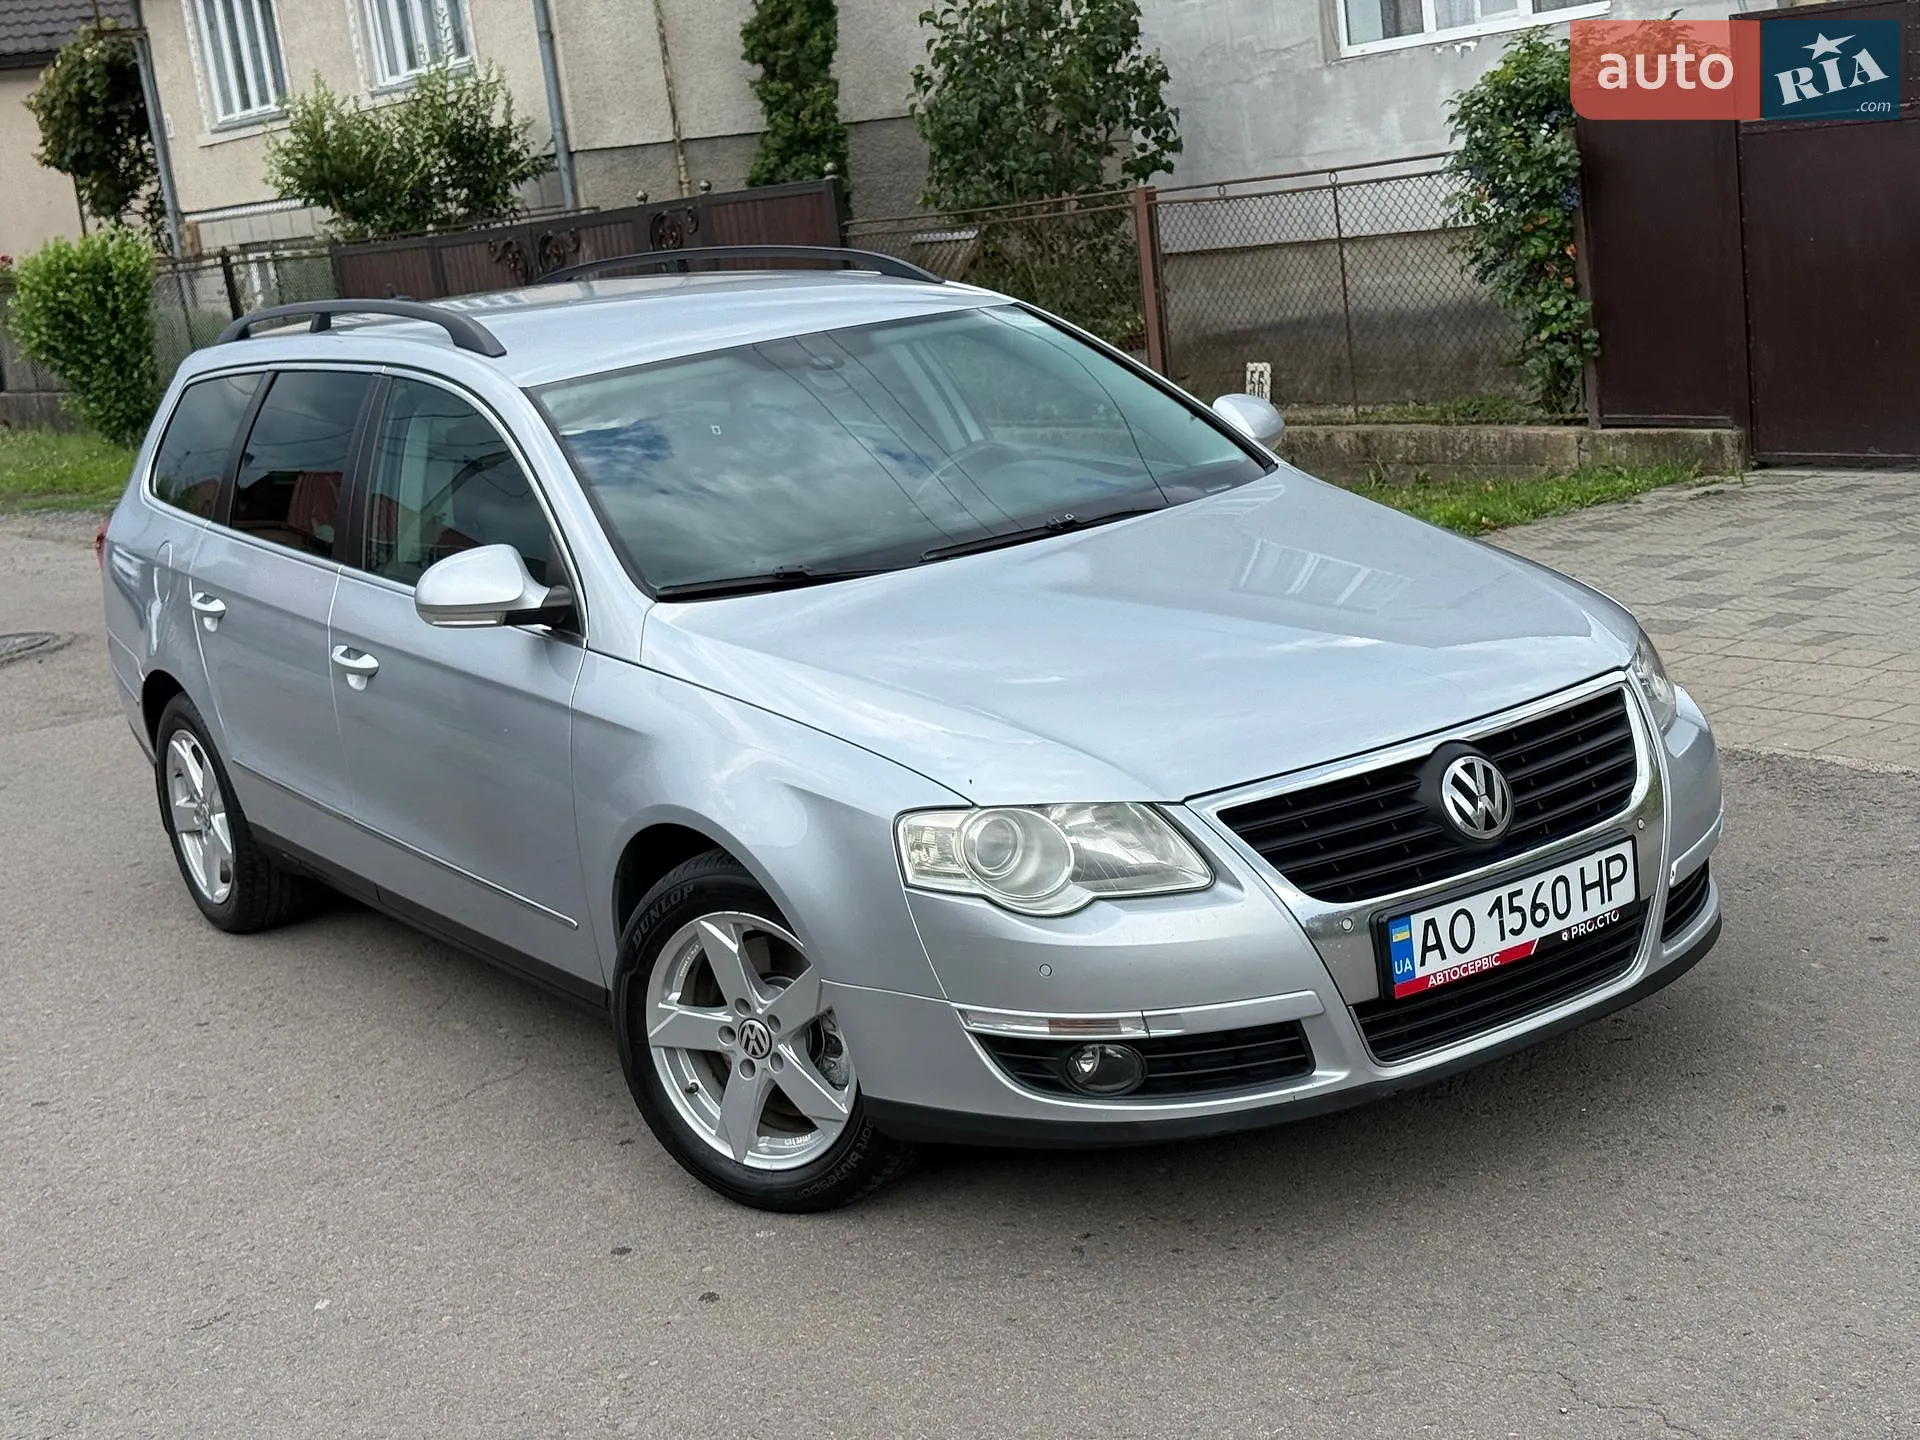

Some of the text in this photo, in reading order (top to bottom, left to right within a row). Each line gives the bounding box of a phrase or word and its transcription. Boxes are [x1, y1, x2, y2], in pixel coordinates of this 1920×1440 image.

[631, 884, 694, 950] DUNLOP
[1419, 853, 1628, 967] AO 1560 HP
[1394, 958, 1413, 975] UA
[1428, 953, 1501, 988] АВТОСЕРВІС
